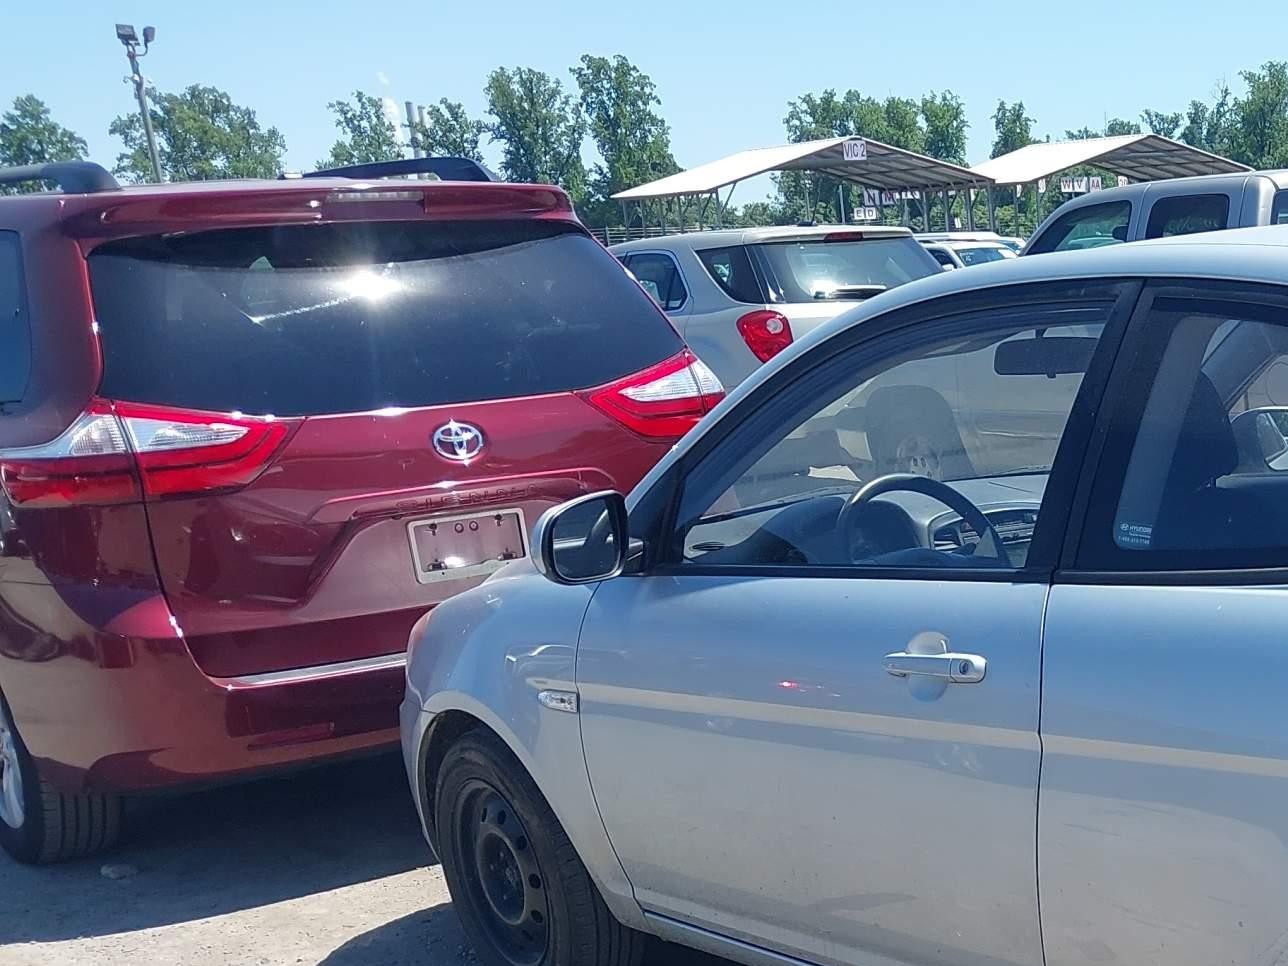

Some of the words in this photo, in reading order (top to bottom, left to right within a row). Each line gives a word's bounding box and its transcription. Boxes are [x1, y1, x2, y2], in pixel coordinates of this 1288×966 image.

[843, 143, 859, 158] VIC
[860, 143, 866, 157] 2
[1062, 180, 1071, 190] W
[1075, 179, 1083, 189] V
[1091, 180, 1100, 188] AA
[856, 209, 861, 218] E
[868, 209, 874, 217] D
